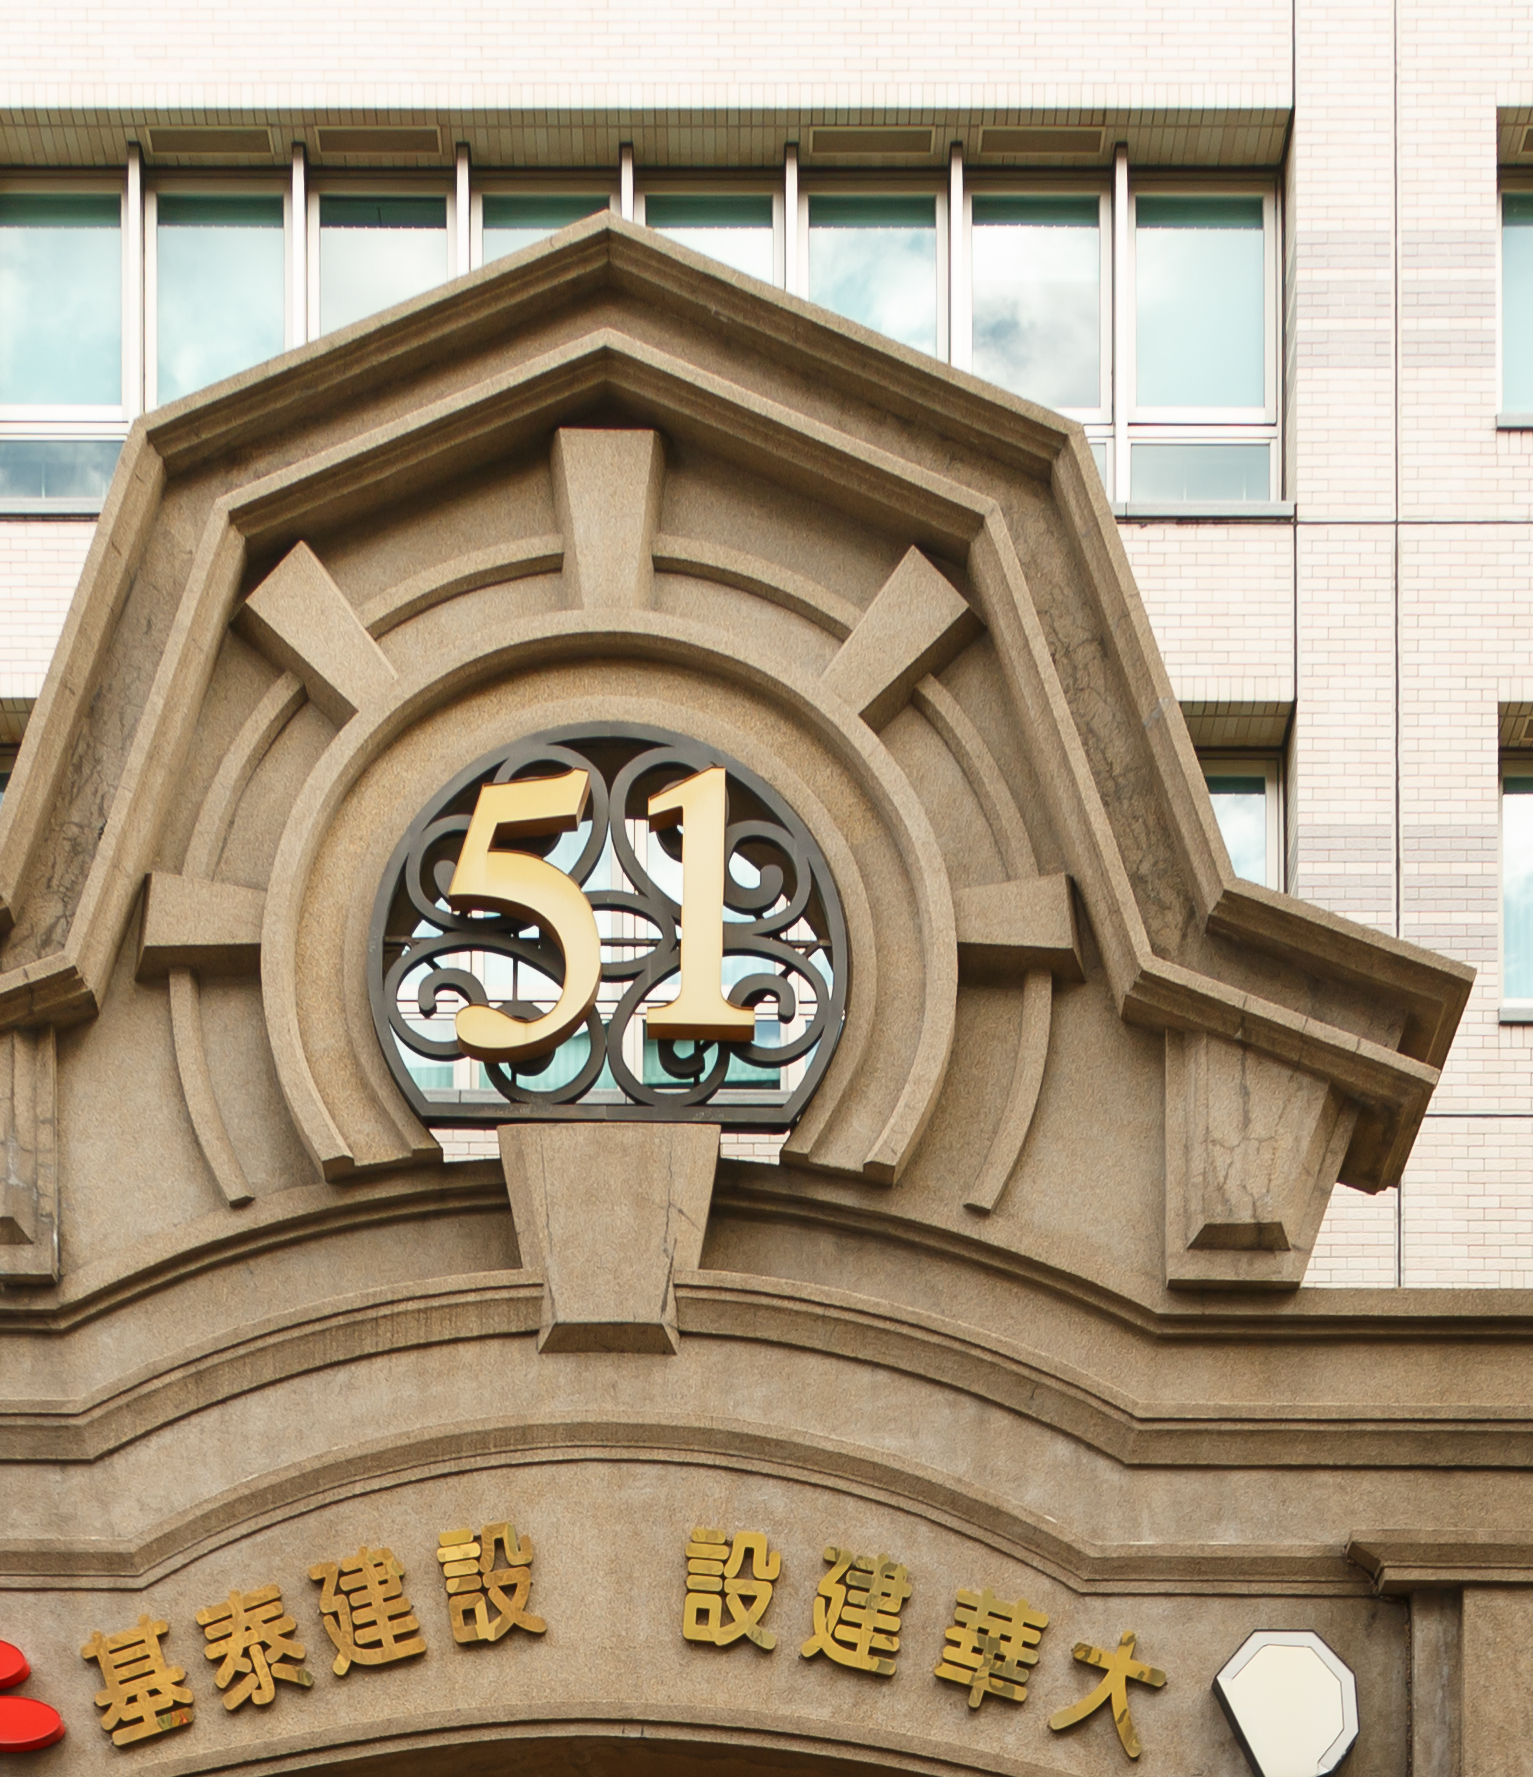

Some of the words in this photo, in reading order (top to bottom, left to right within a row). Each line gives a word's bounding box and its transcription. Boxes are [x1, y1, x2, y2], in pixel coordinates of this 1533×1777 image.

[448, 766, 756, 1063] 51
[80, 1520, 548, 1747] 基泰建設
